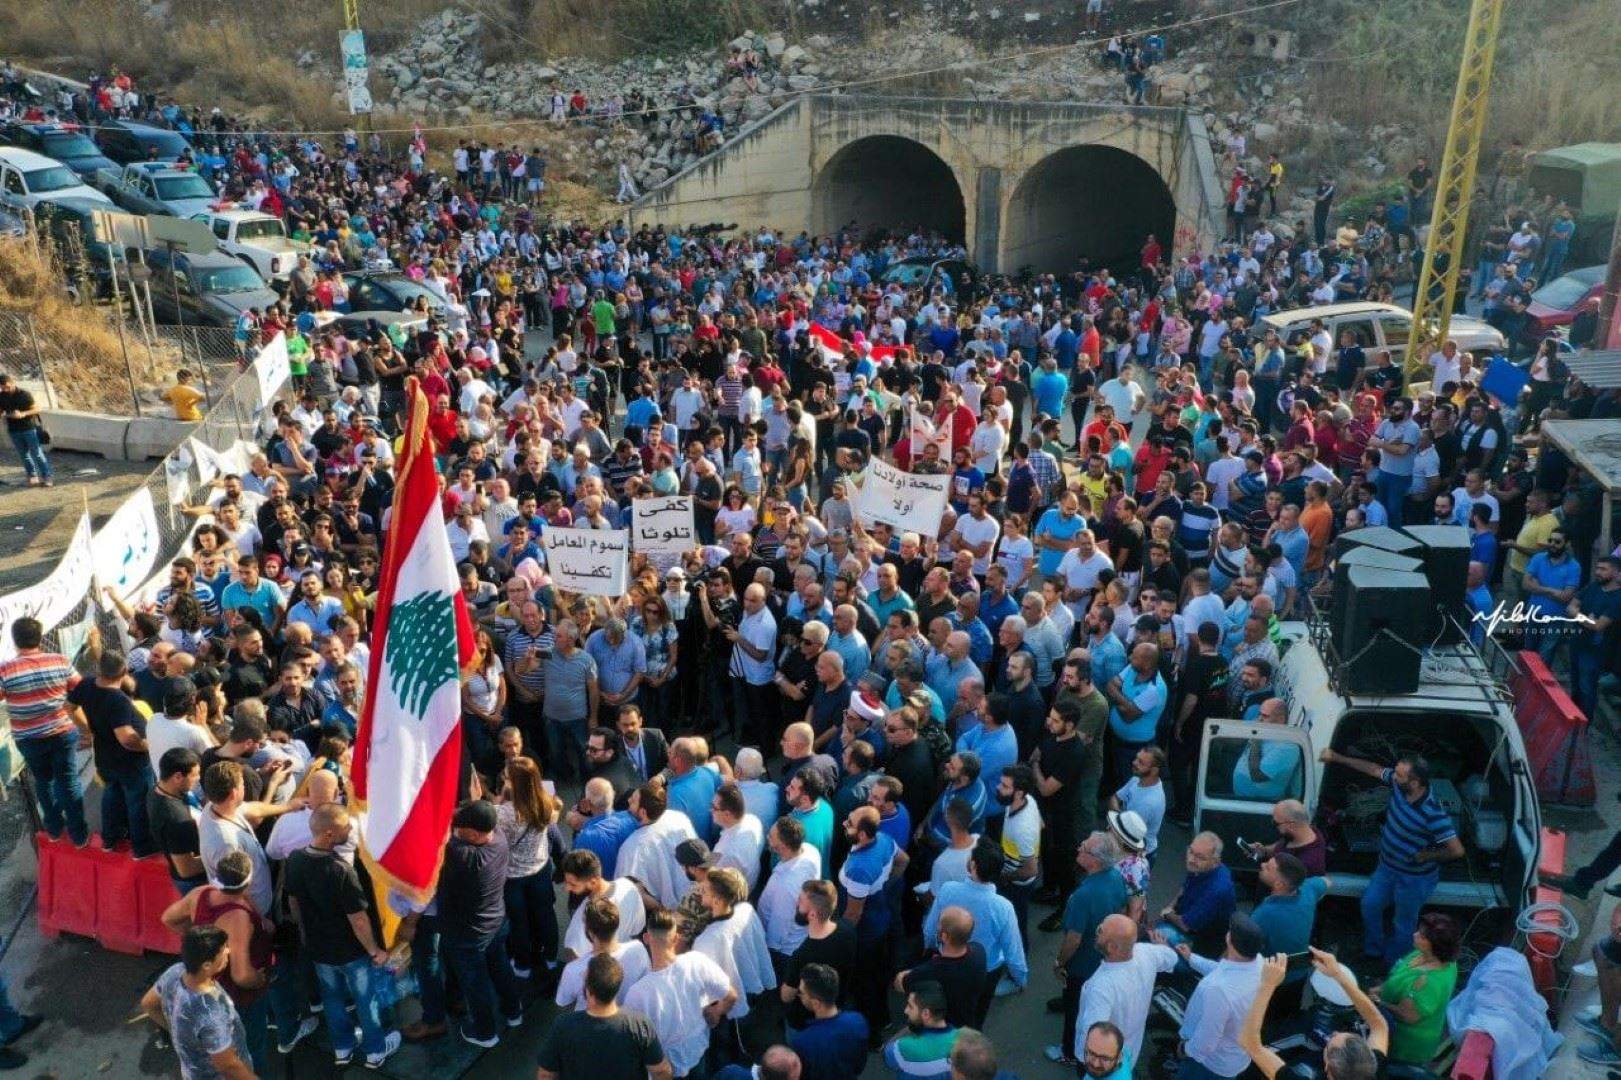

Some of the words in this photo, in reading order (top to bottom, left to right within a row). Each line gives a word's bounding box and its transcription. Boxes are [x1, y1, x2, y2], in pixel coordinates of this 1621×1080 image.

[639, 499, 689, 517] كفى
[548, 534, 587, 549] المعامل
[590, 539, 624, 554] سموم
